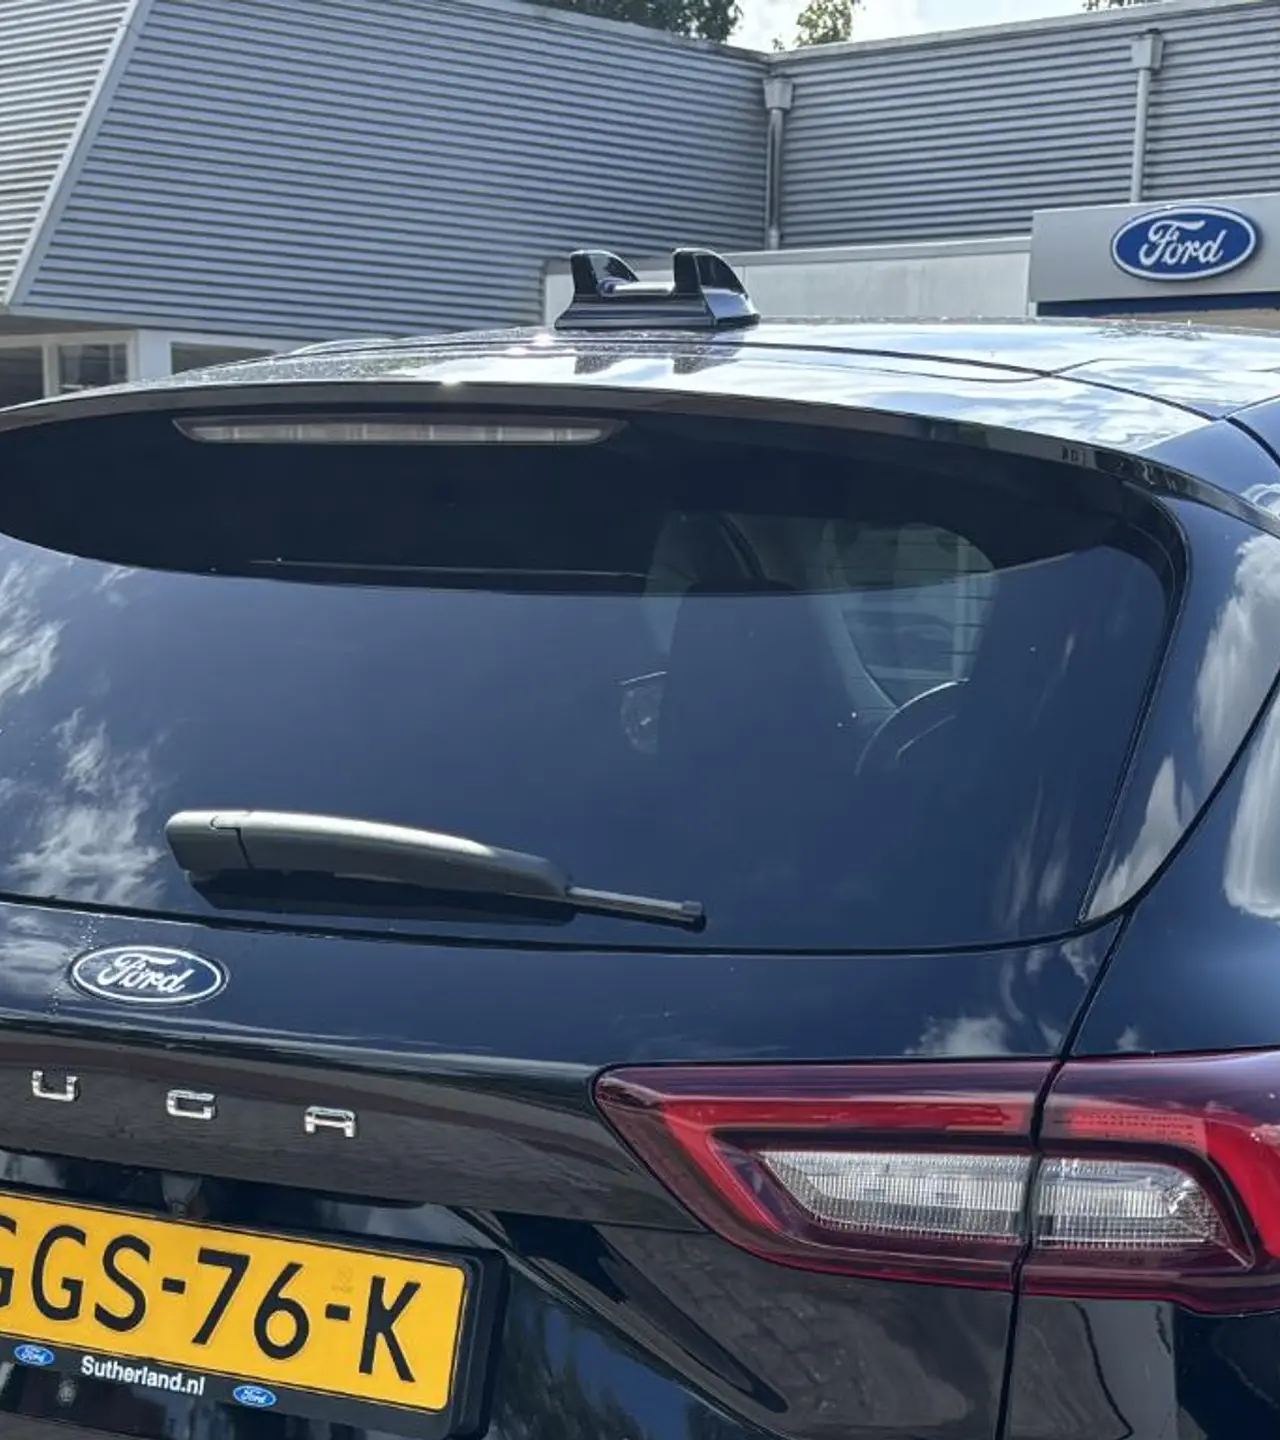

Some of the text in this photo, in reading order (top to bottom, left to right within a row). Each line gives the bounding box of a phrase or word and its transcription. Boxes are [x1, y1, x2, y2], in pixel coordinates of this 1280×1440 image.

[1139, 219, 1224, 267] Ford
[97, 953, 195, 993] Ford
[80, 1354, 206, 1397] Sutherland.nl
